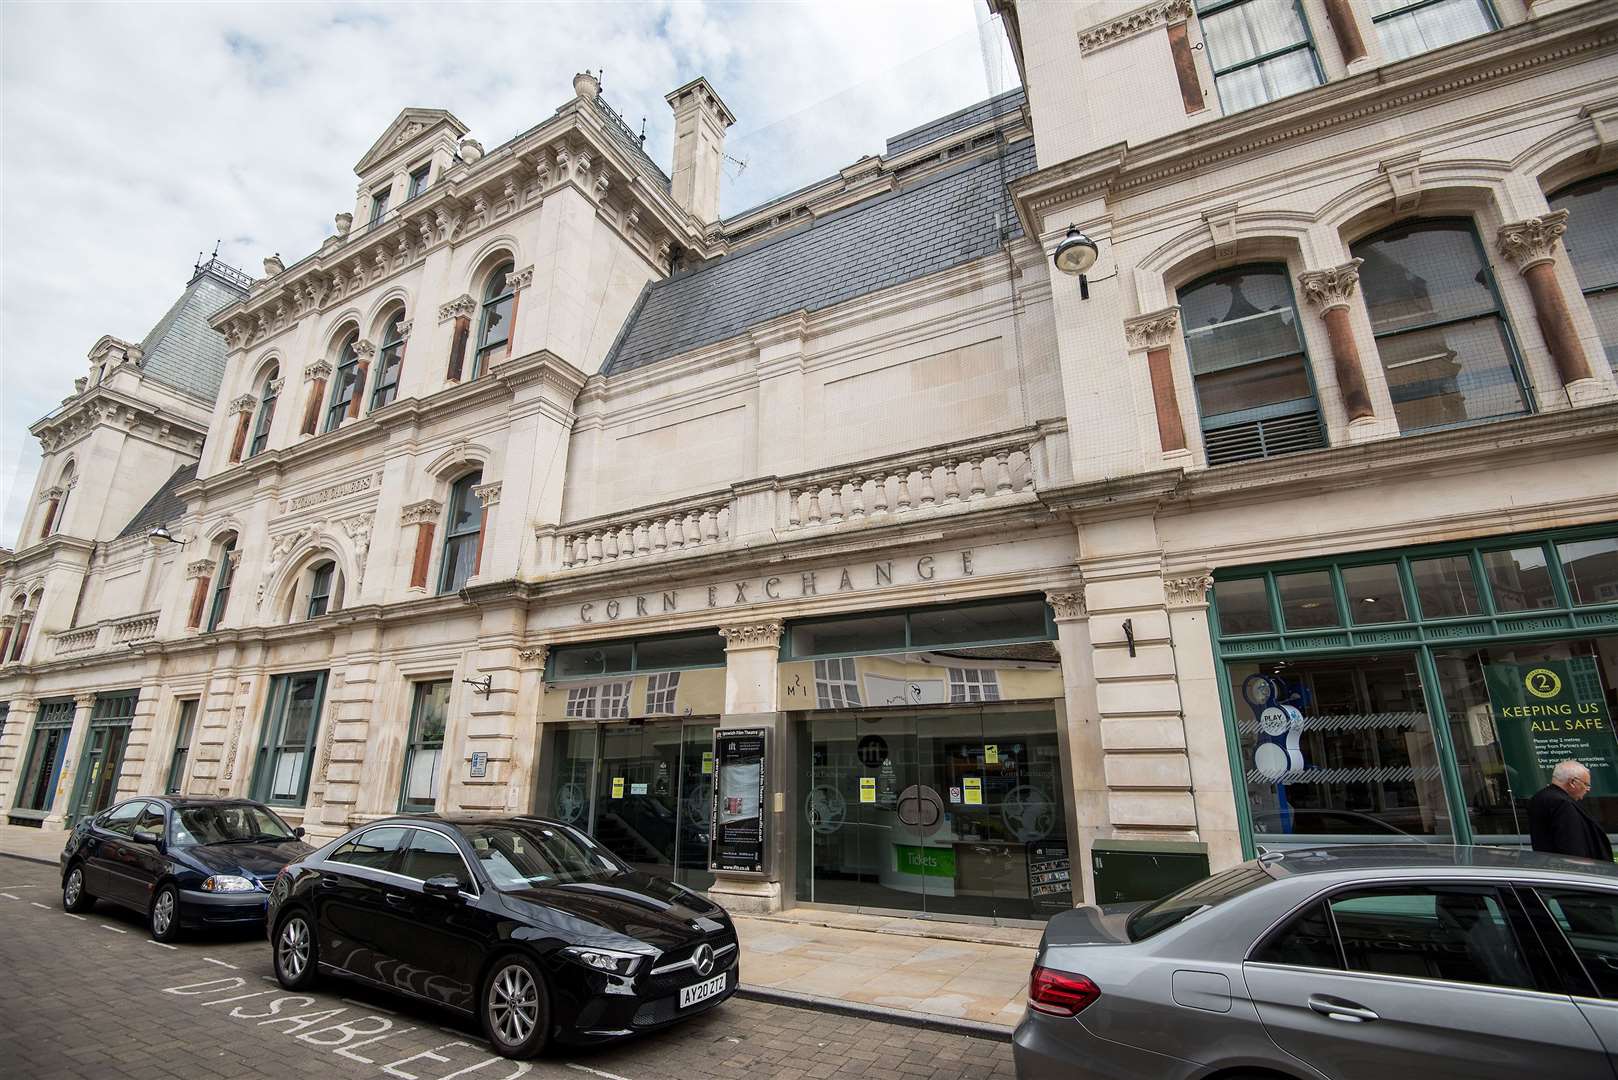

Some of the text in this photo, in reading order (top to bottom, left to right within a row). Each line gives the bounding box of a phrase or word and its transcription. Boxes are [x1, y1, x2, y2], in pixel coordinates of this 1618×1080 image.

[580, 550, 975, 623] CORN EXCHANGE
[1536, 674, 1550, 688] 2
[1502, 703, 1599, 717] KEEPING US
[1531, 718, 1604, 732] ALL SAFE
[908, 852, 937, 867] Tickets
[684, 976, 724, 1004] AY20 ZTZ
